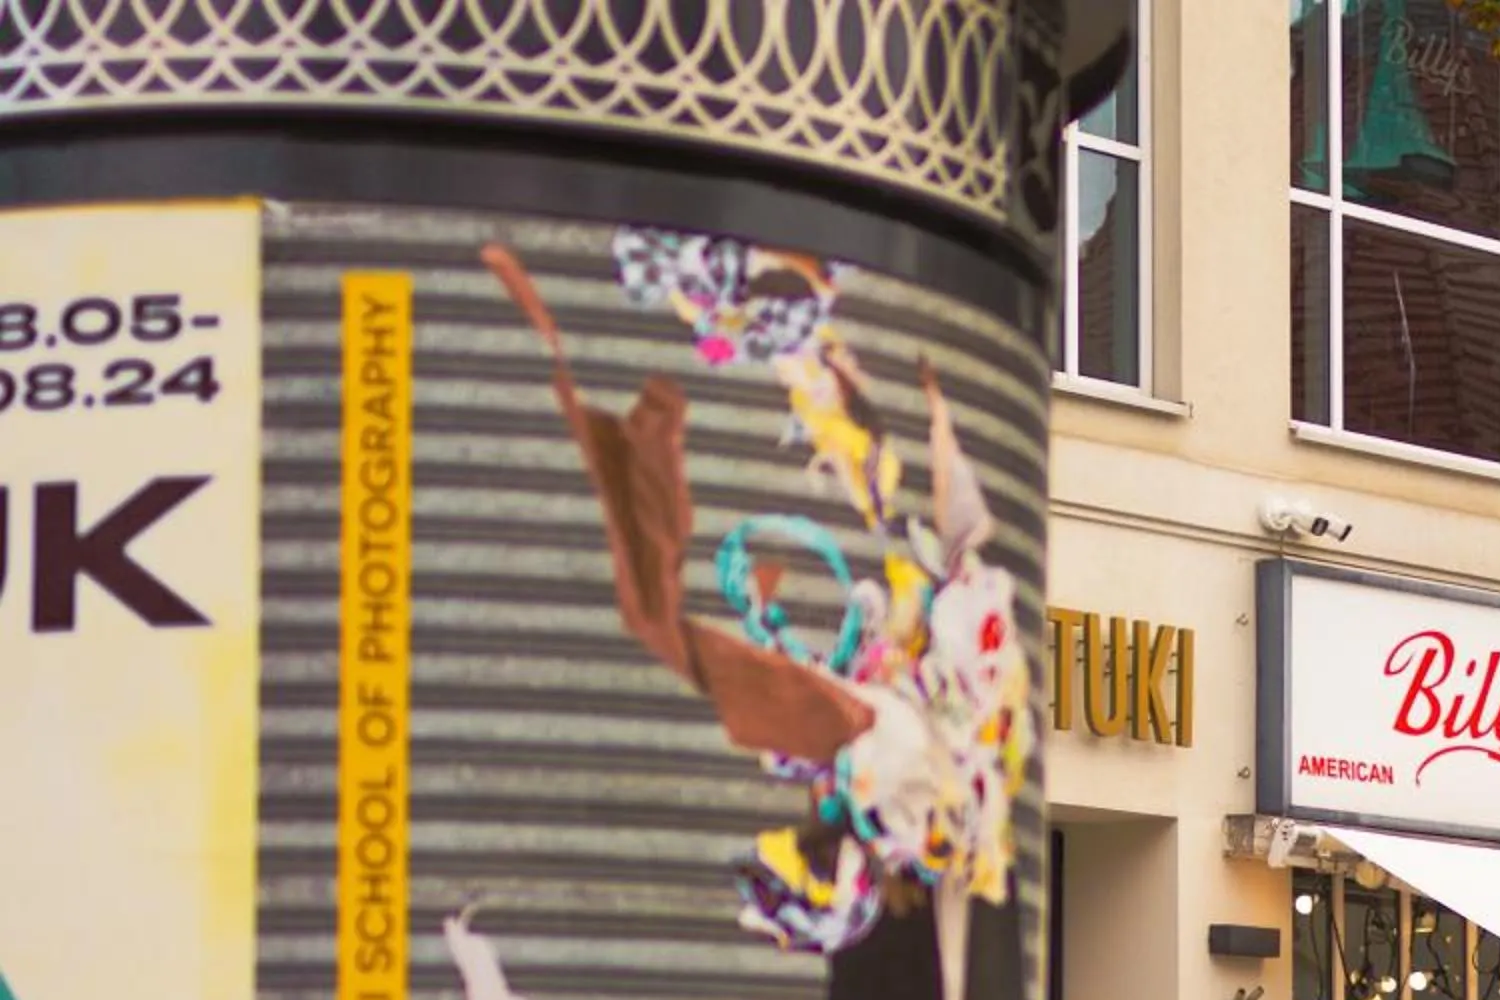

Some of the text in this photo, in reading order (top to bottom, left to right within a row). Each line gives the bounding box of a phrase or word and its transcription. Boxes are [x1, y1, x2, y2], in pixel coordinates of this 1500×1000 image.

[0, 357, 219, 414] 8.24
[358, 293, 397, 664] PHOTOGRAPHY
[0, 476, 213, 632] K
[357, 683, 395, 747] OF
[1298, 754, 1394, 785] AMERICAN
[354, 768, 395, 974] SCHOOL
